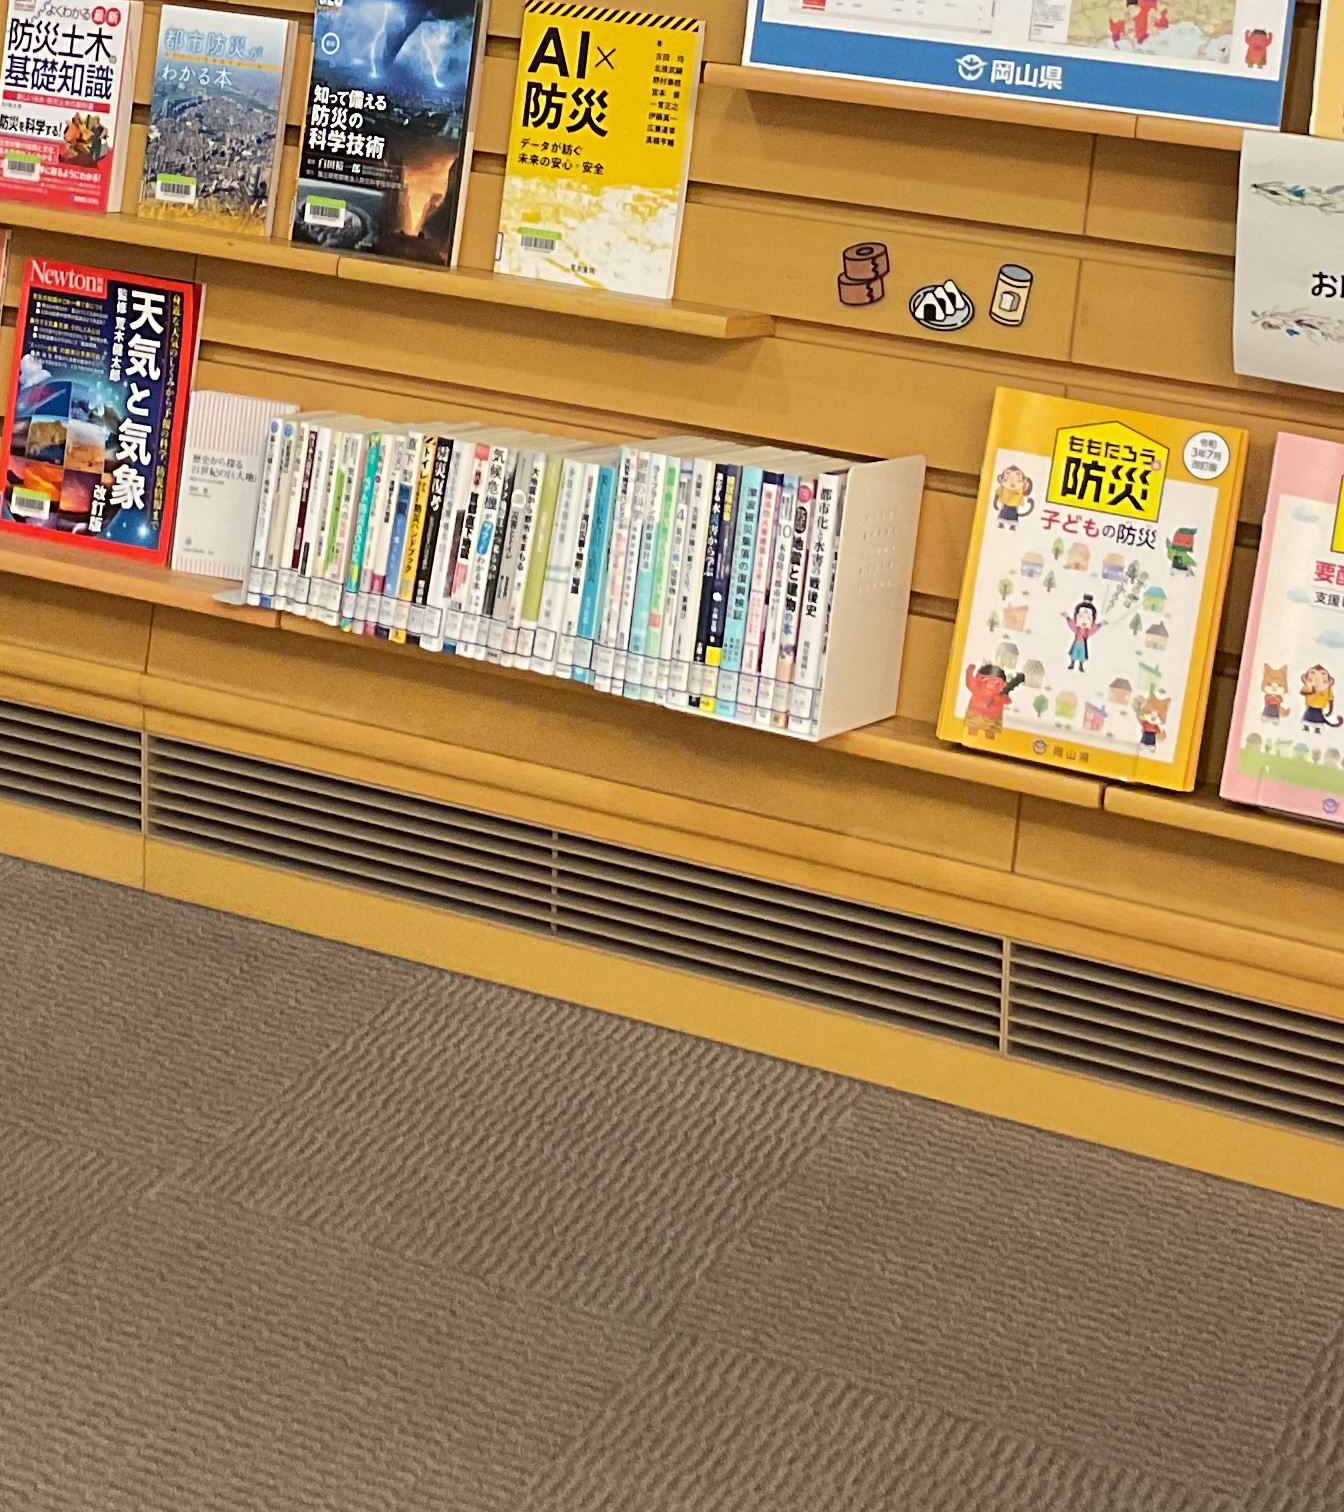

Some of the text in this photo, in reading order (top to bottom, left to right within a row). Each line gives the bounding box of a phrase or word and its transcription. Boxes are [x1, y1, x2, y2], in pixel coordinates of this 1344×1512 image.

[45, 5, 92, 21] よくわかる
[164, 27, 264, 61] 都市防災が
[4, 53, 115, 101] 基礎知識
[161, 61, 234, 90] わかる本
[989, 59, 1064, 90] 岡山県
[313, 83, 388, 111] 知って備える
[521, 80, 610, 138] 防災
[310, 103, 364, 131] 防災の
[308, 128, 386, 161] 科学技術
[519, 137, 583, 157] データが紡ぐ
[516, 152, 605, 176] 未来の安心・安全
[29, 258, 97, 293] Newton
[108, 288, 166, 512] 天気と気象
[1068, 435, 1156, 466] ももたろう
[1060, 455, 1153, 513] 防災
[87, 483, 108, 534] 改訂版
[1040, 509, 1158, 551] 子どもの防災
